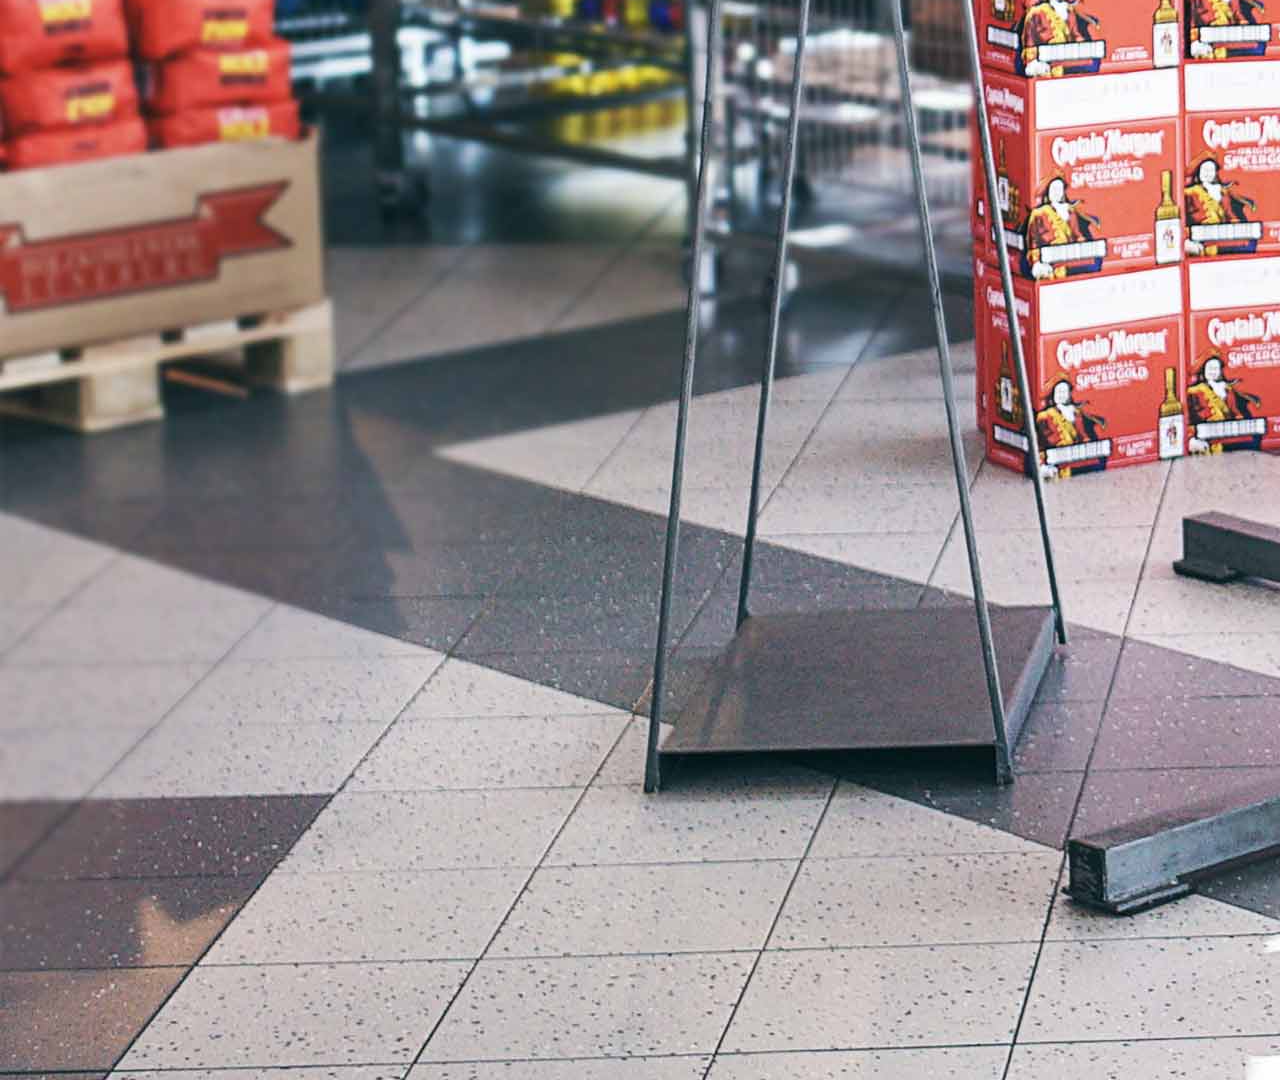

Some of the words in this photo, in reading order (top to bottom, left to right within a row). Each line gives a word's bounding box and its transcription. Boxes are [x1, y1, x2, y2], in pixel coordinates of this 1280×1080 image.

[1051, 133, 1104, 166] Captain
[1103, 130, 1164, 162] Morgan
[1202, 117, 1260, 149] Captain
[1111, 167, 1144, 183] GOLD
[1208, 315, 1265, 347] Captain
[1056, 334, 1111, 370] Captain
[1108, 329, 1167, 361] Morgan
[1116, 366, 1149, 382] GOLD
